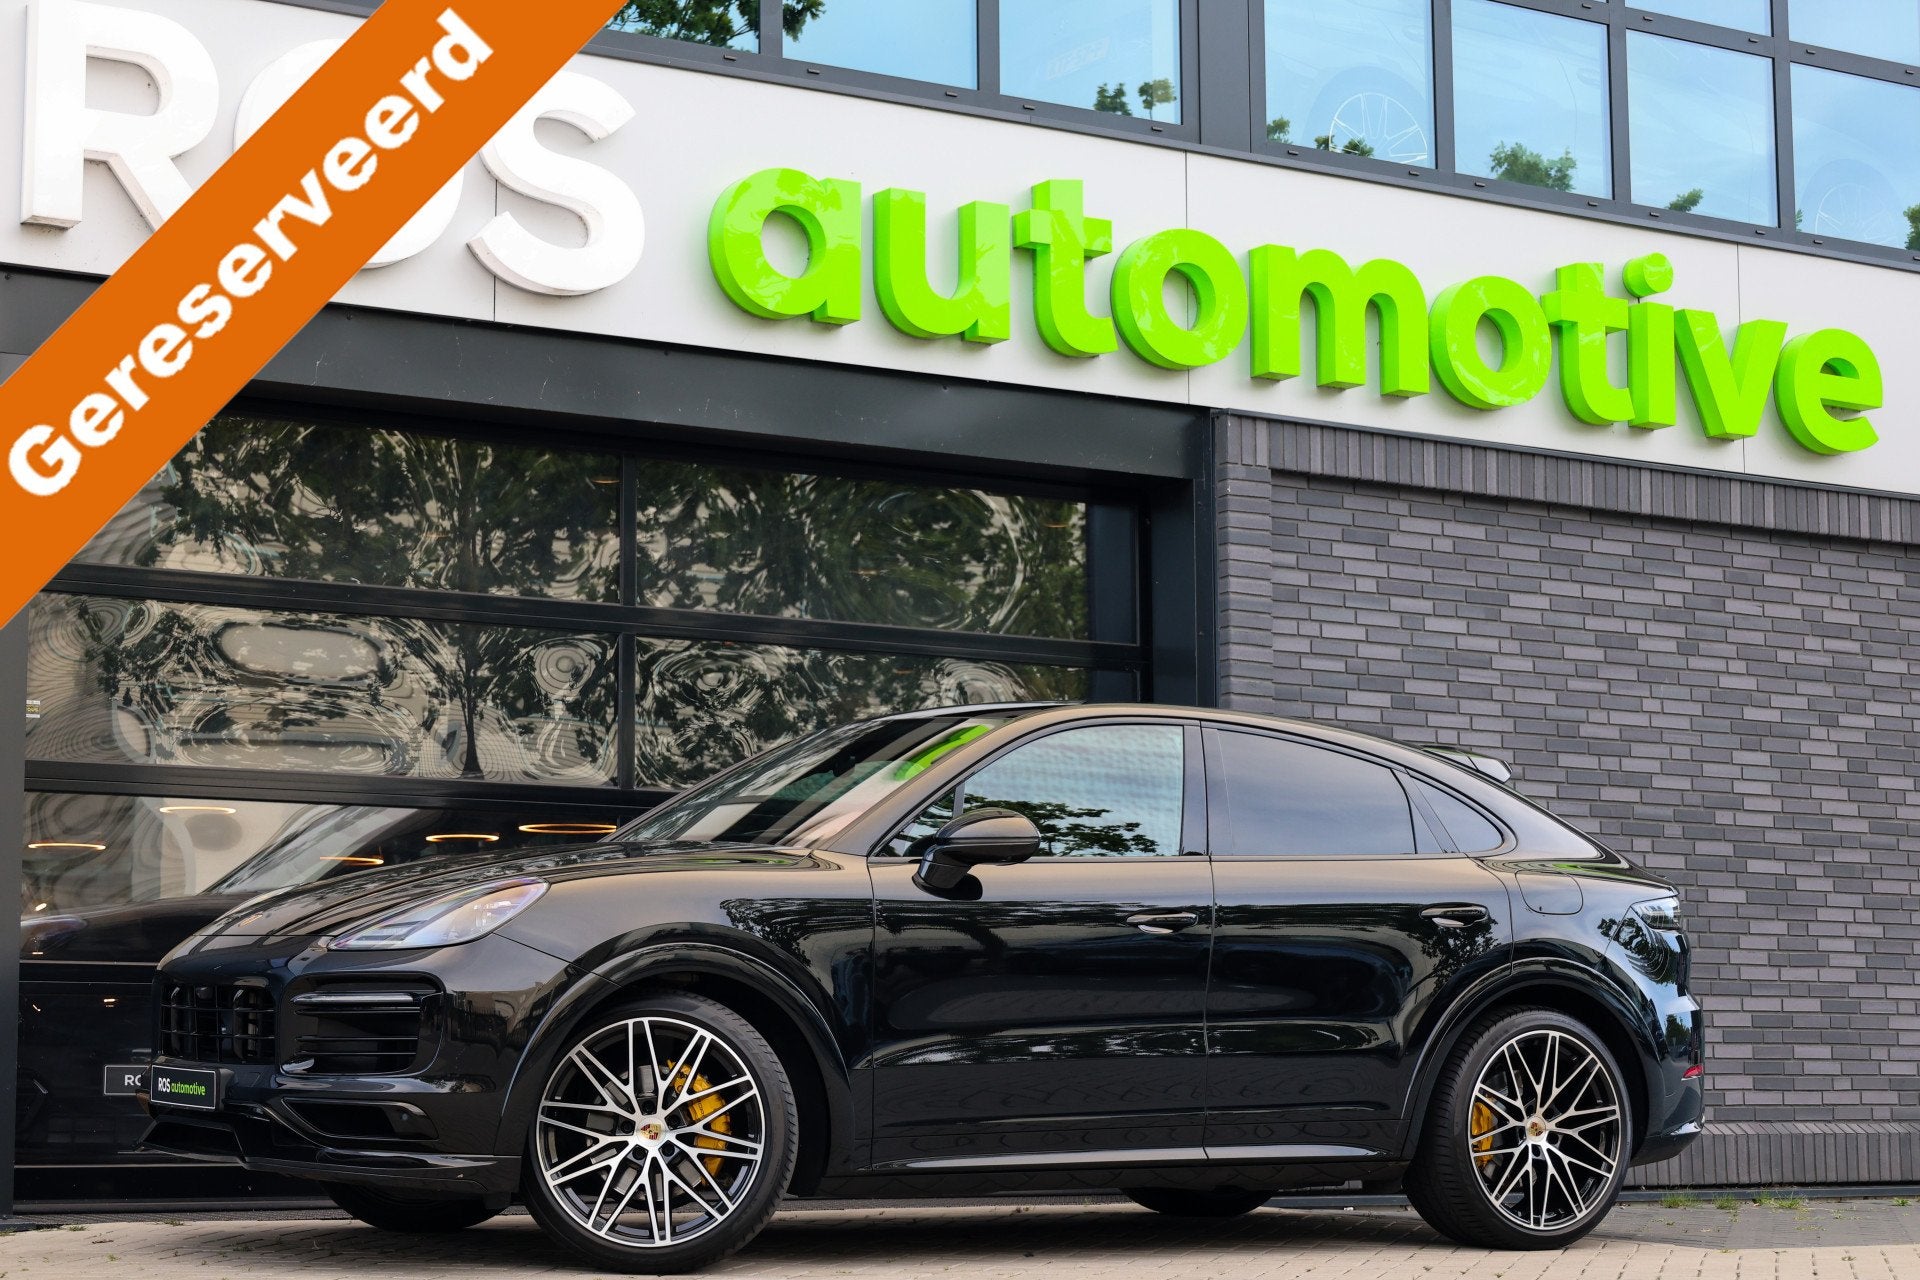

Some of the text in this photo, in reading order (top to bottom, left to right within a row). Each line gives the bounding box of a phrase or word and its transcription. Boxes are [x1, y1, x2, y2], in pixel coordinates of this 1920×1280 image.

[20, 0, 1883, 455] RS automotive
[158, 1077, 206, 1096] ROS automotive
